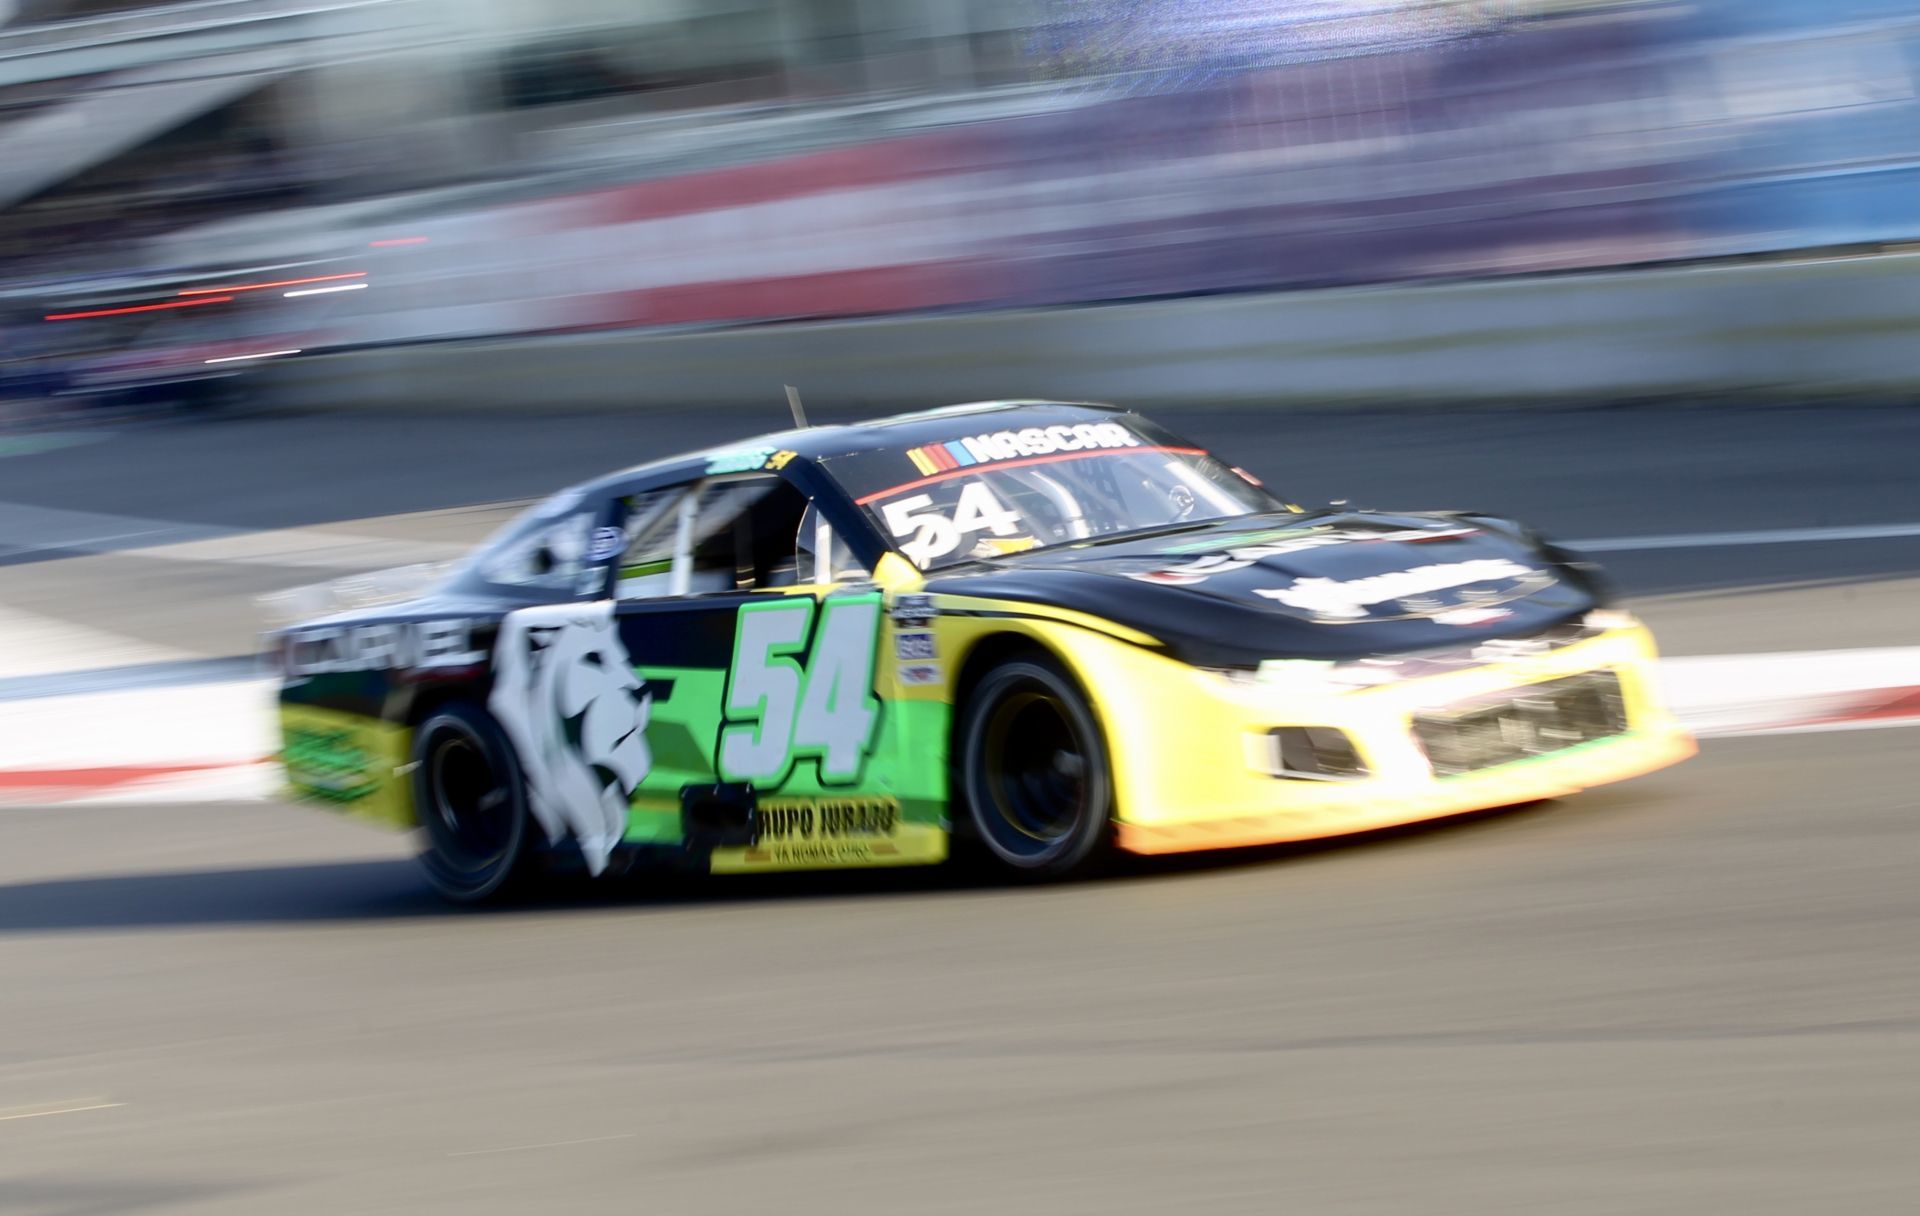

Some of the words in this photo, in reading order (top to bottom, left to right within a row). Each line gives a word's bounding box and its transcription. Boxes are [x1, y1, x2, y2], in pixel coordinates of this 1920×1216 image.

[961, 423, 1140, 463] NASCAR
[881, 481, 1021, 561] 54
[717, 594, 882, 788] 54
